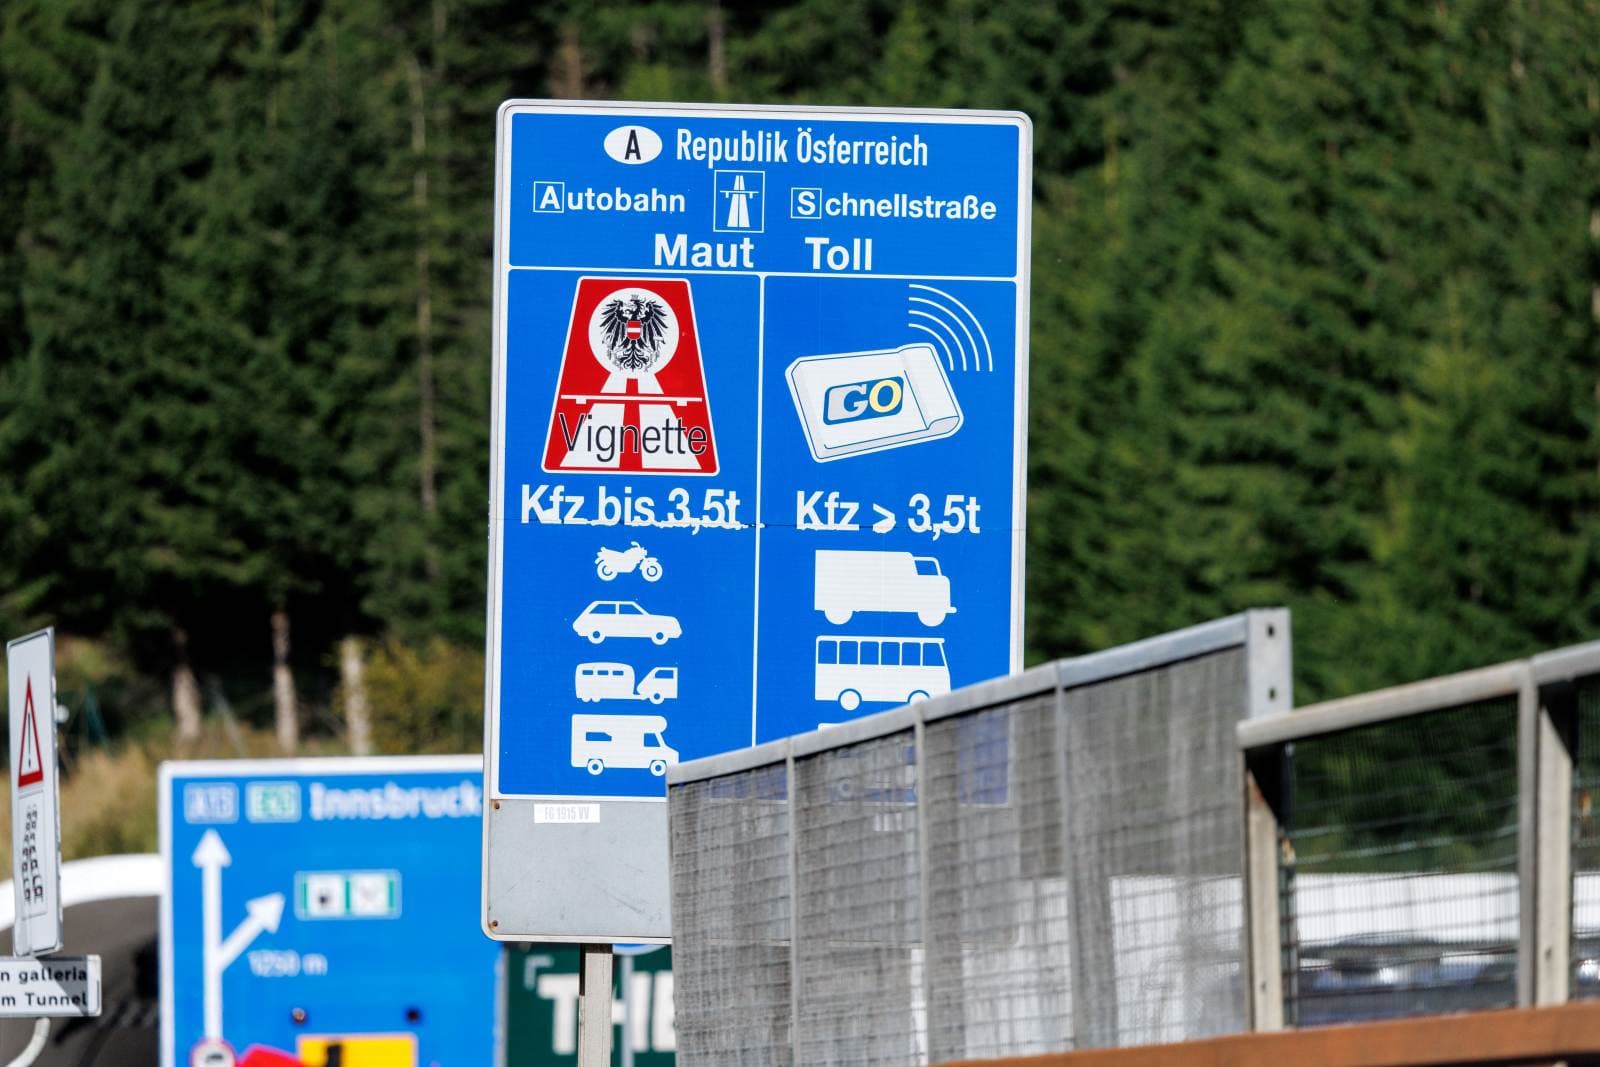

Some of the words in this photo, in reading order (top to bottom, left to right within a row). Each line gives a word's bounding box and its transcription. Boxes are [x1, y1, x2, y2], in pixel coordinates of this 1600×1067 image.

[624, 129, 642, 160] A
[677, 128, 789, 169] Republik
[797, 127, 928, 166] Österreich
[539, 185, 686, 213] Autobahn
[797, 190, 998, 220] Schnellstraße
[654, 233, 755, 268] Maut
[804, 236, 873, 271] Toll
[827, 379, 902, 421] GO
[559, 412, 708, 463] Vignette
[521, 484, 586, 525] Kfz
[598, 485, 657, 527] bis
[668, 487, 741, 535] 3,5t
[796, 490, 860, 531] Kfz
[907, 493, 981, 541] 3,5t
[310, 780, 481, 821] Innsbruck
[18, 966, 87, 985] galleria
[24, 991, 87, 1007] Tunnel
